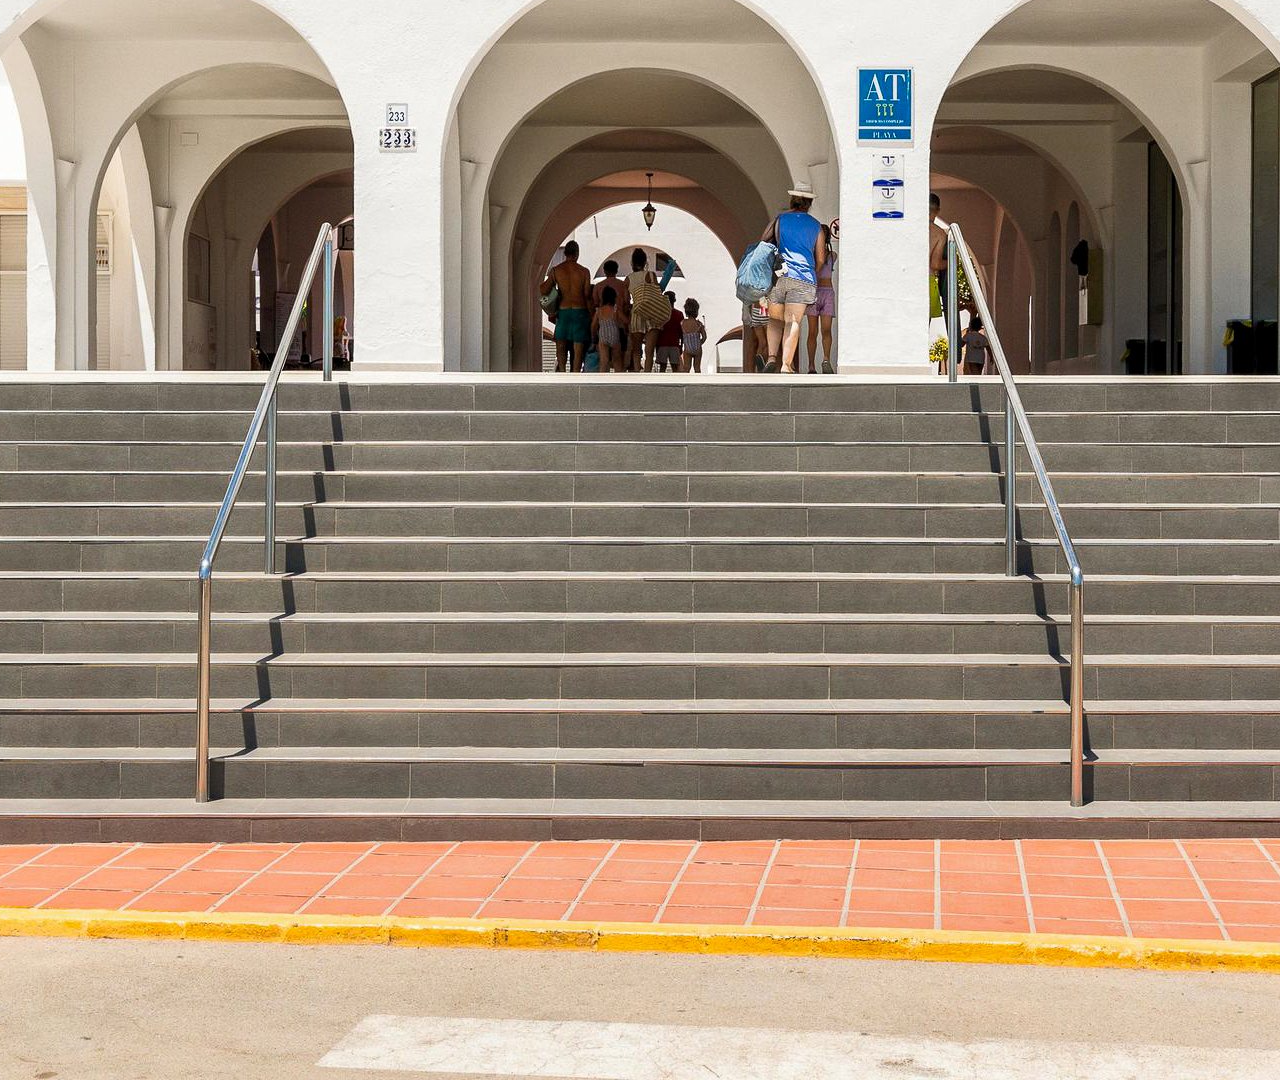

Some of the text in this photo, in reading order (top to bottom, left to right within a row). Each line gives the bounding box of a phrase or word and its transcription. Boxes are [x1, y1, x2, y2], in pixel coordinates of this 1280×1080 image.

[863, 73, 906, 101] AT
[388, 111, 405, 122] 233
[383, 130, 411, 145] 233
[872, 131, 897, 139] PLAYA
